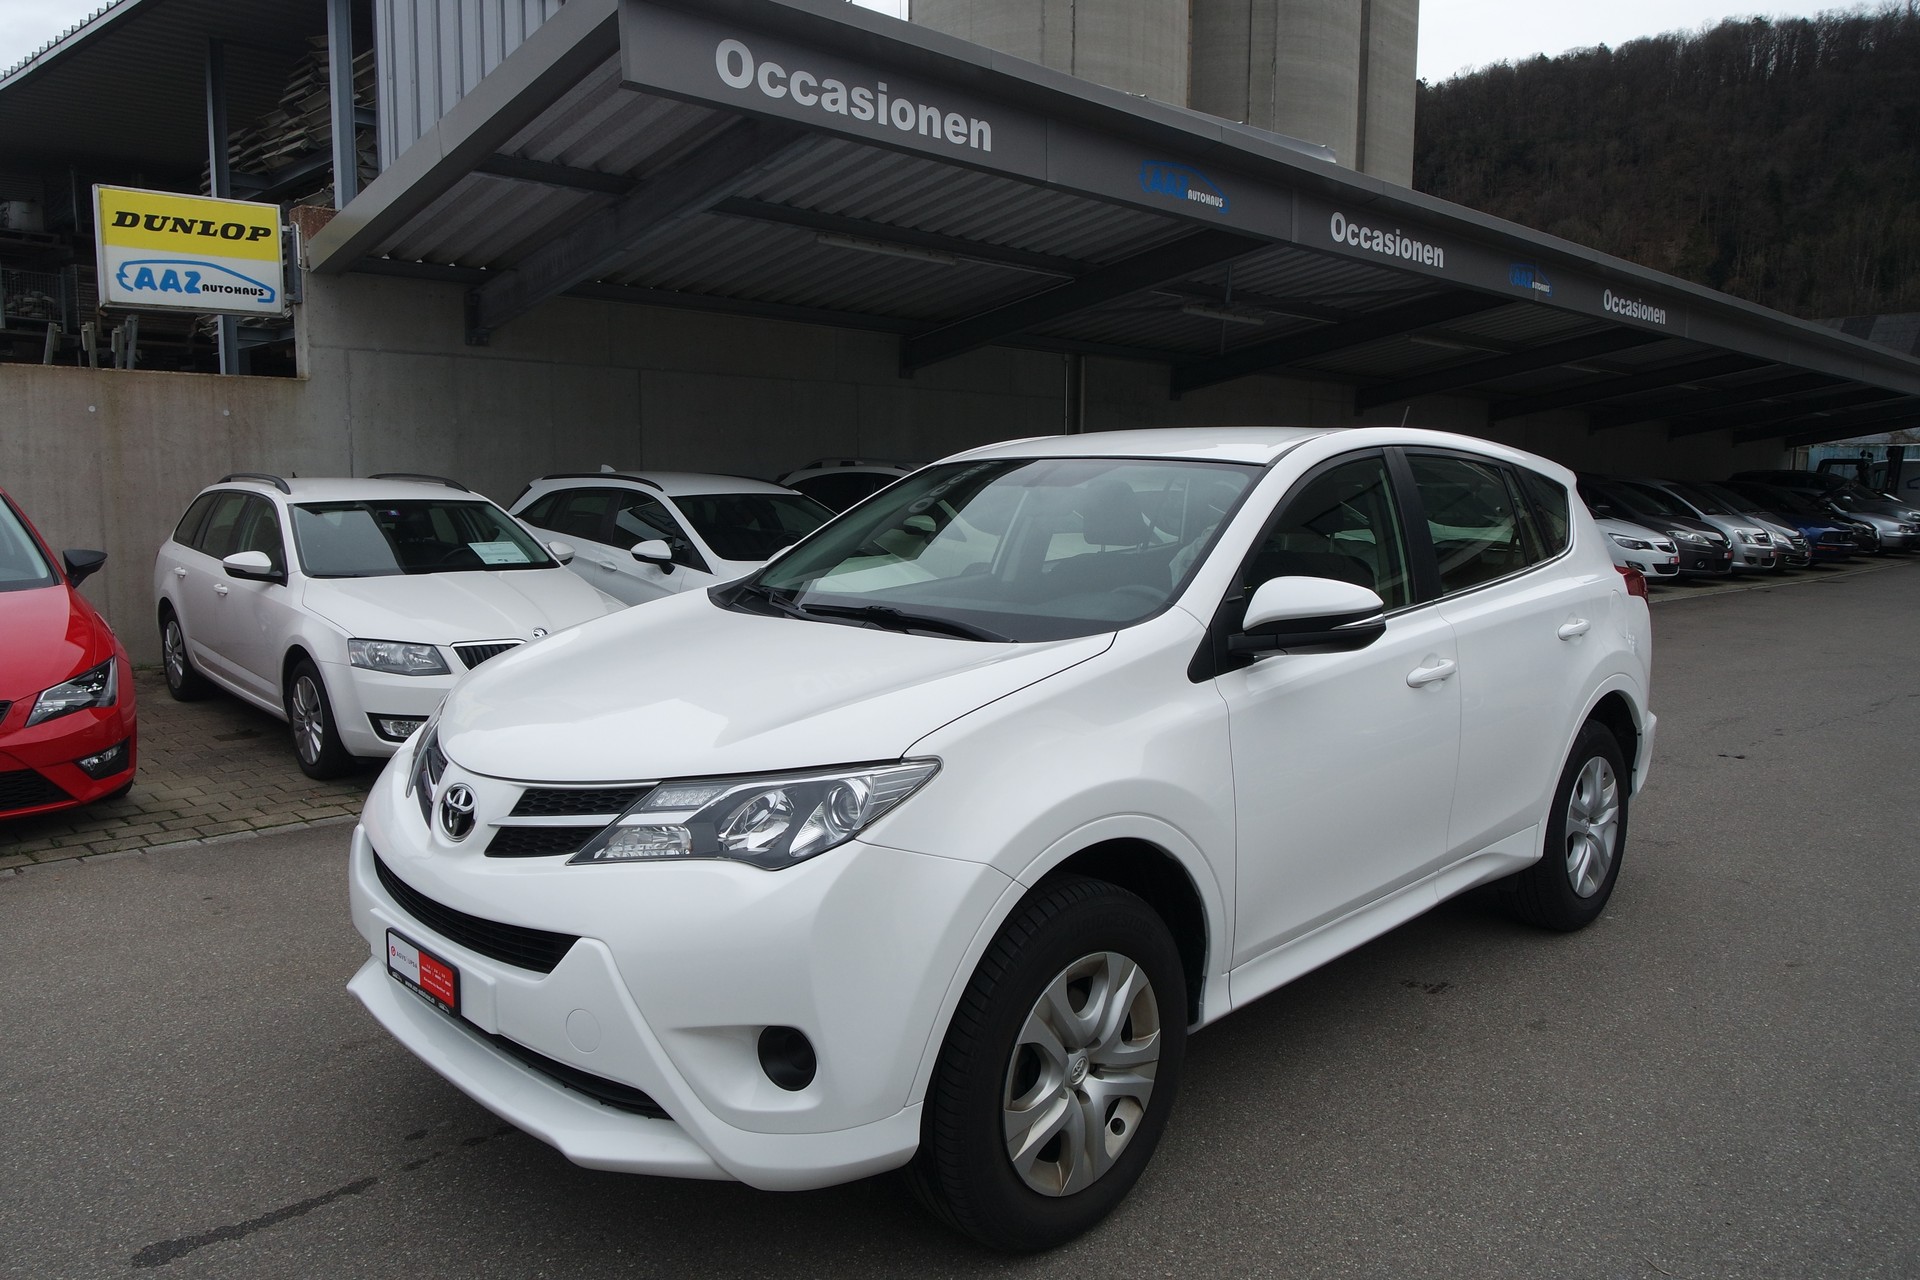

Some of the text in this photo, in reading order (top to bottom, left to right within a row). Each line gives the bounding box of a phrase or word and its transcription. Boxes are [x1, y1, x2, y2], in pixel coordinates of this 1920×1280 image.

[715, 38, 992, 152] Occasionen
[1187, 189, 1223, 208] AUTOHAUS
[112, 211, 272, 242] DUNLOP
[1330, 211, 1444, 268] Occasionen
[202, 283, 265, 297] AUTOHAUS
[1603, 288, 1666, 325] Occasionen
